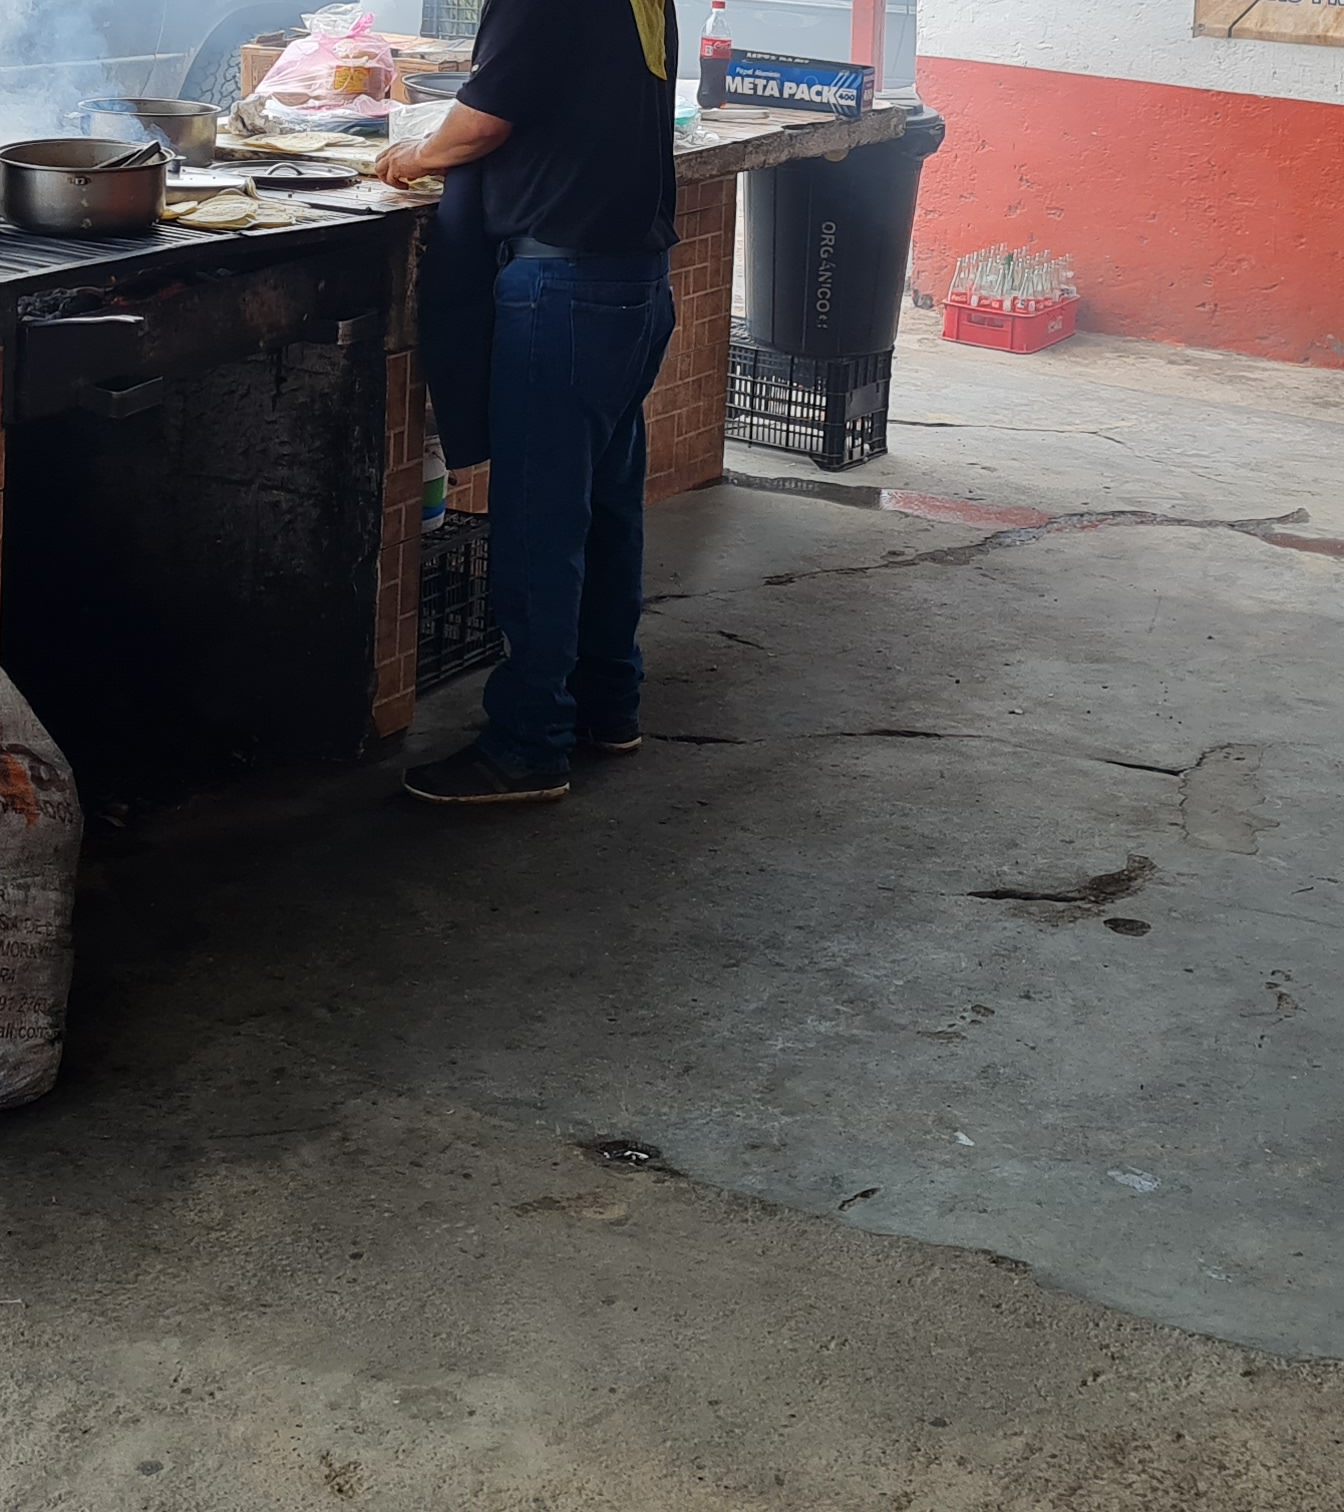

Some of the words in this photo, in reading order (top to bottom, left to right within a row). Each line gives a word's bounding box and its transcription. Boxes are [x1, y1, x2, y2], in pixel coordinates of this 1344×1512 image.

[726, 75, 780, 98] META
[782, 81, 837, 104] PACK
[838, 93, 855, 101] 400
